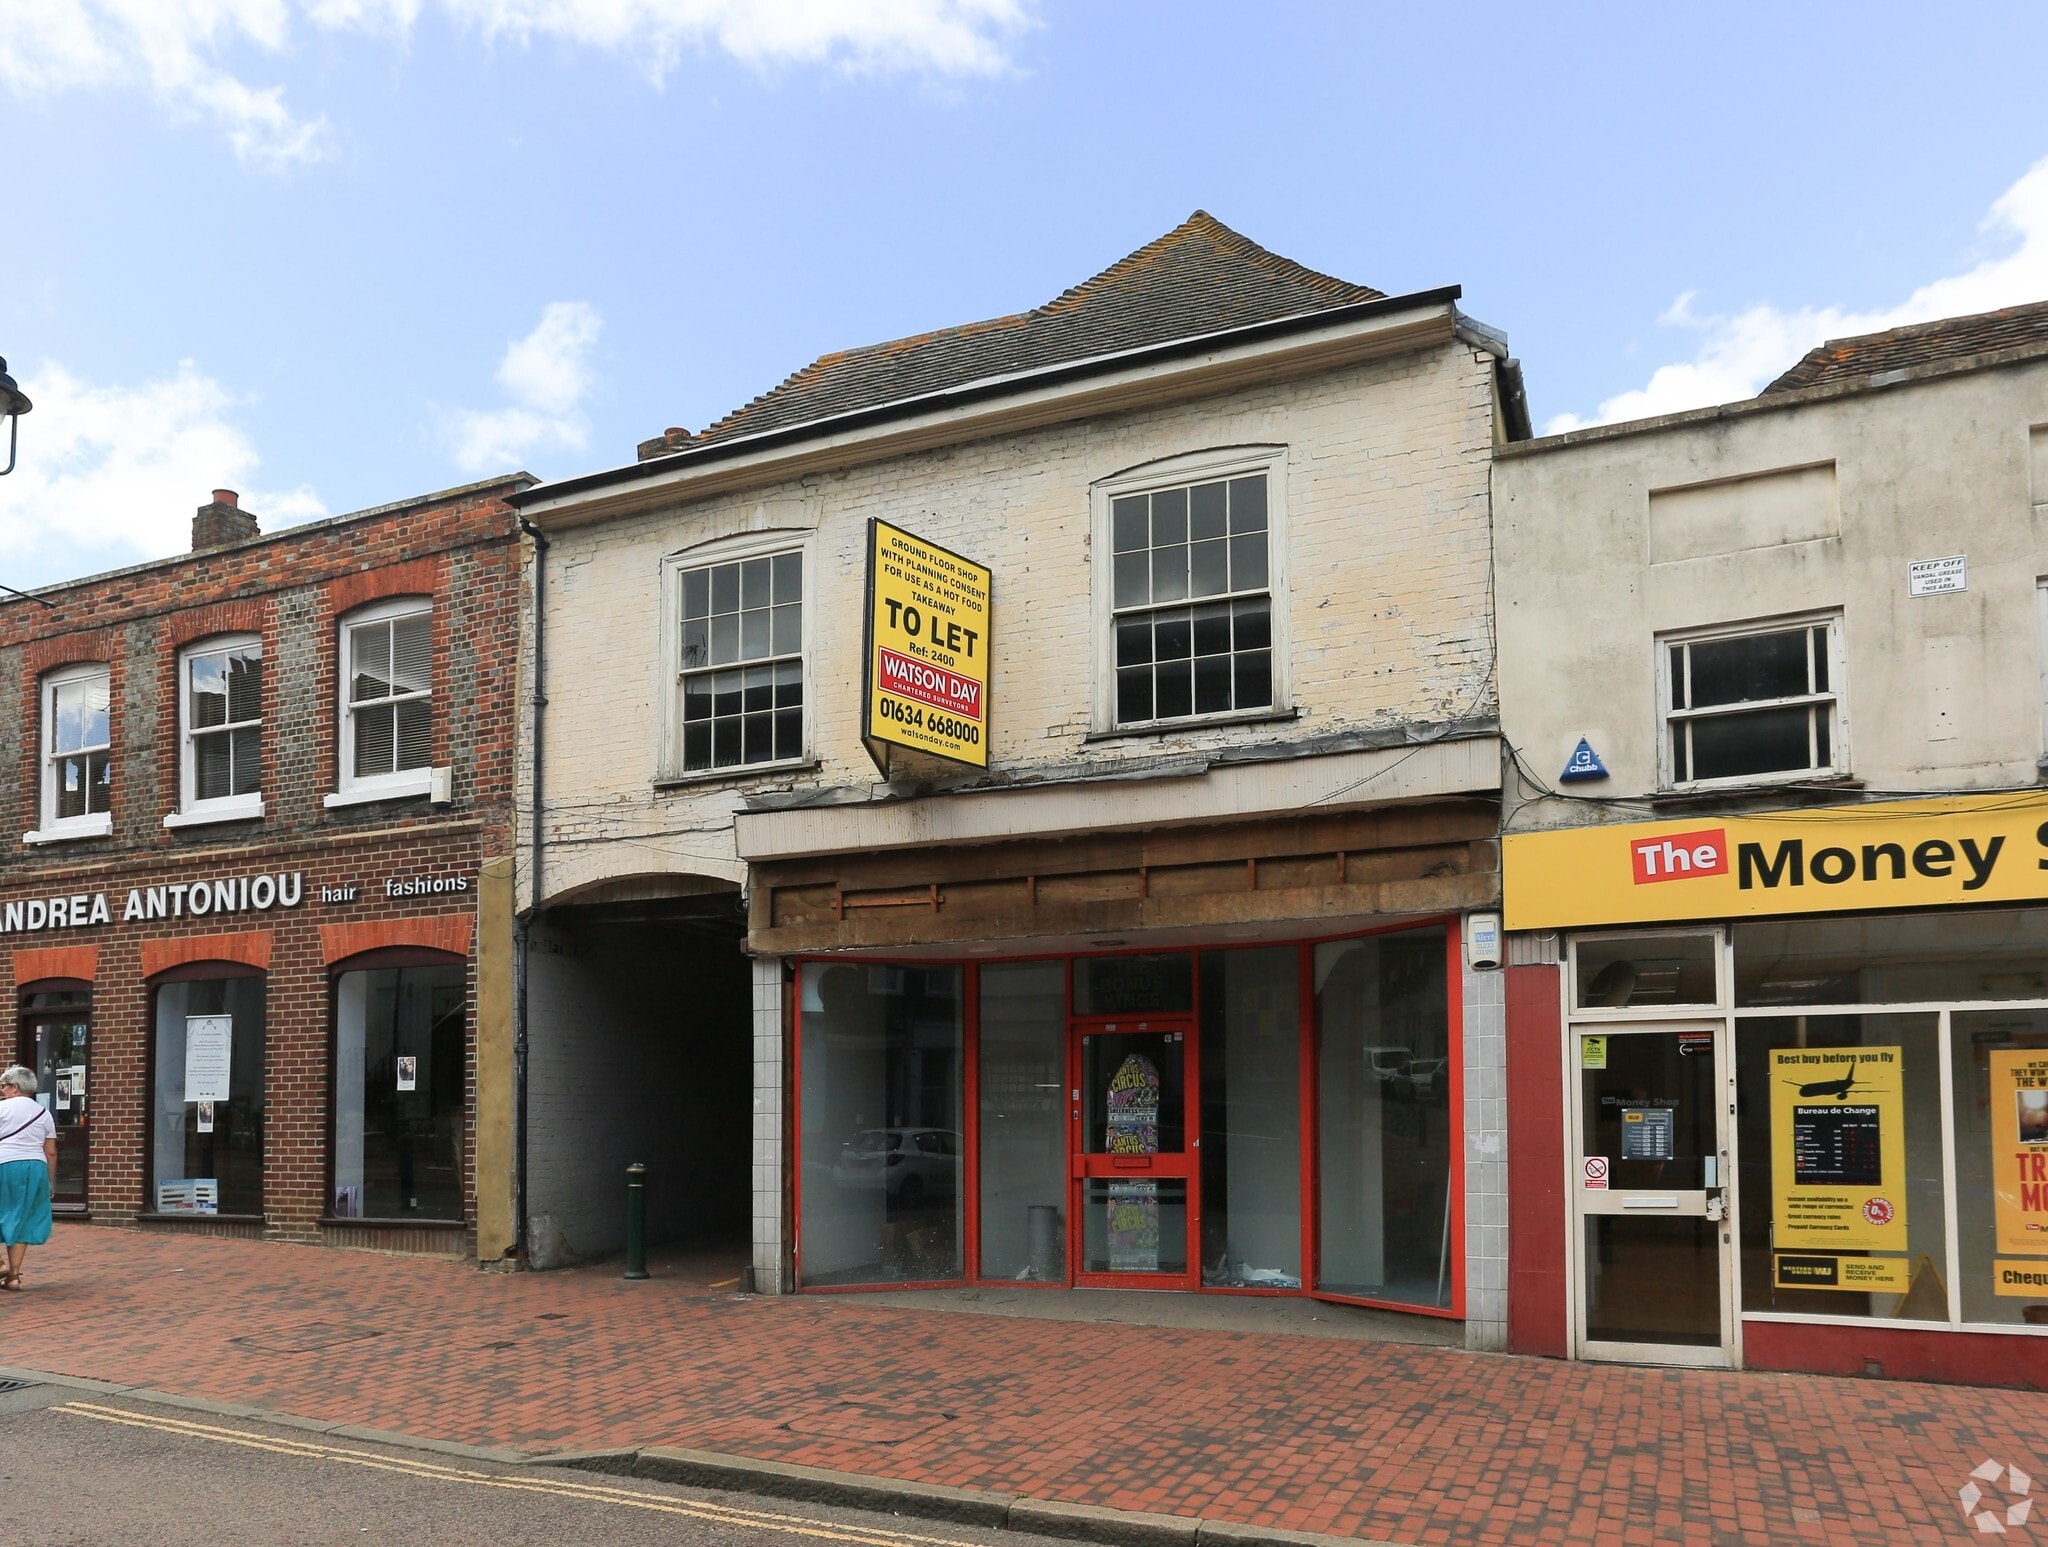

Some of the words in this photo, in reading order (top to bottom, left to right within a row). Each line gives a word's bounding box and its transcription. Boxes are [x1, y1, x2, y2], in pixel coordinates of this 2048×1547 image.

[891, 537, 927, 561] GROUND
[929, 554, 955, 573] FLOOR
[958, 567, 977, 583] SHOP
[1913, 563, 1940, 571] KEEP
[881, 548, 903, 565] WITH
[906, 559, 948, 584] PLANNING
[950, 578, 985, 600] CONSENT
[885, 564, 902, 578] FOR
[905, 572, 921, 587] USE
[923, 580, 934, 592] AS
[936, 586, 942, 595] A
[943, 590, 959, 602] HOT
[962, 597, 982, 612] FOOD
[912, 591, 956, 615] TAKEAWAY
[885, 598, 921, 636] TO
[931, 616, 977, 658] LET
[910, 642, 928, 658] Ref:
[931, 650, 954, 667] 2400
[884, 655, 946, 693] WATSON
[950, 678, 977, 704] DAY
[893, 682, 931, 699] CHARTERED
[933, 694, 969, 712] SURVEYORS
[880, 697, 923, 728] 01634
[928, 713, 979, 745] 668000
[901, 727, 960, 751] watsonday.com
[1570, 764, 1598, 773] Chubb
[1637, 841, 1717, 875] The
[1738, 835, 2006, 890] Money
[0, 893, 112, 932] NDREA
[123, 872, 301, 920] ANTONIOU
[322, 884, 357, 902] hair
[386, 876, 468, 897] fashions
[1777, 1055, 1800, 1064] Best
[1802, 1054, 1820, 1064] buy
[1823, 1054, 1856, 1063] before
[1859, 1054, 1878, 1063] you
[1881, 1052, 1894, 1062] fly
[1112, 1073, 1146, 1093] CIRCUS
[2010, 1069, 2028, 1077] THEY
[2016, 1077, 2035, 1087] THE
[1616, 1098, 1651, 1107] Money
[1653, 1097, 1680, 1107] Shop
[1843, 1107, 1877, 1115] Change
[1112, 1135, 1139, 1149] SANTUS
[1112, 1212, 1146, 1234] CIRCUS
